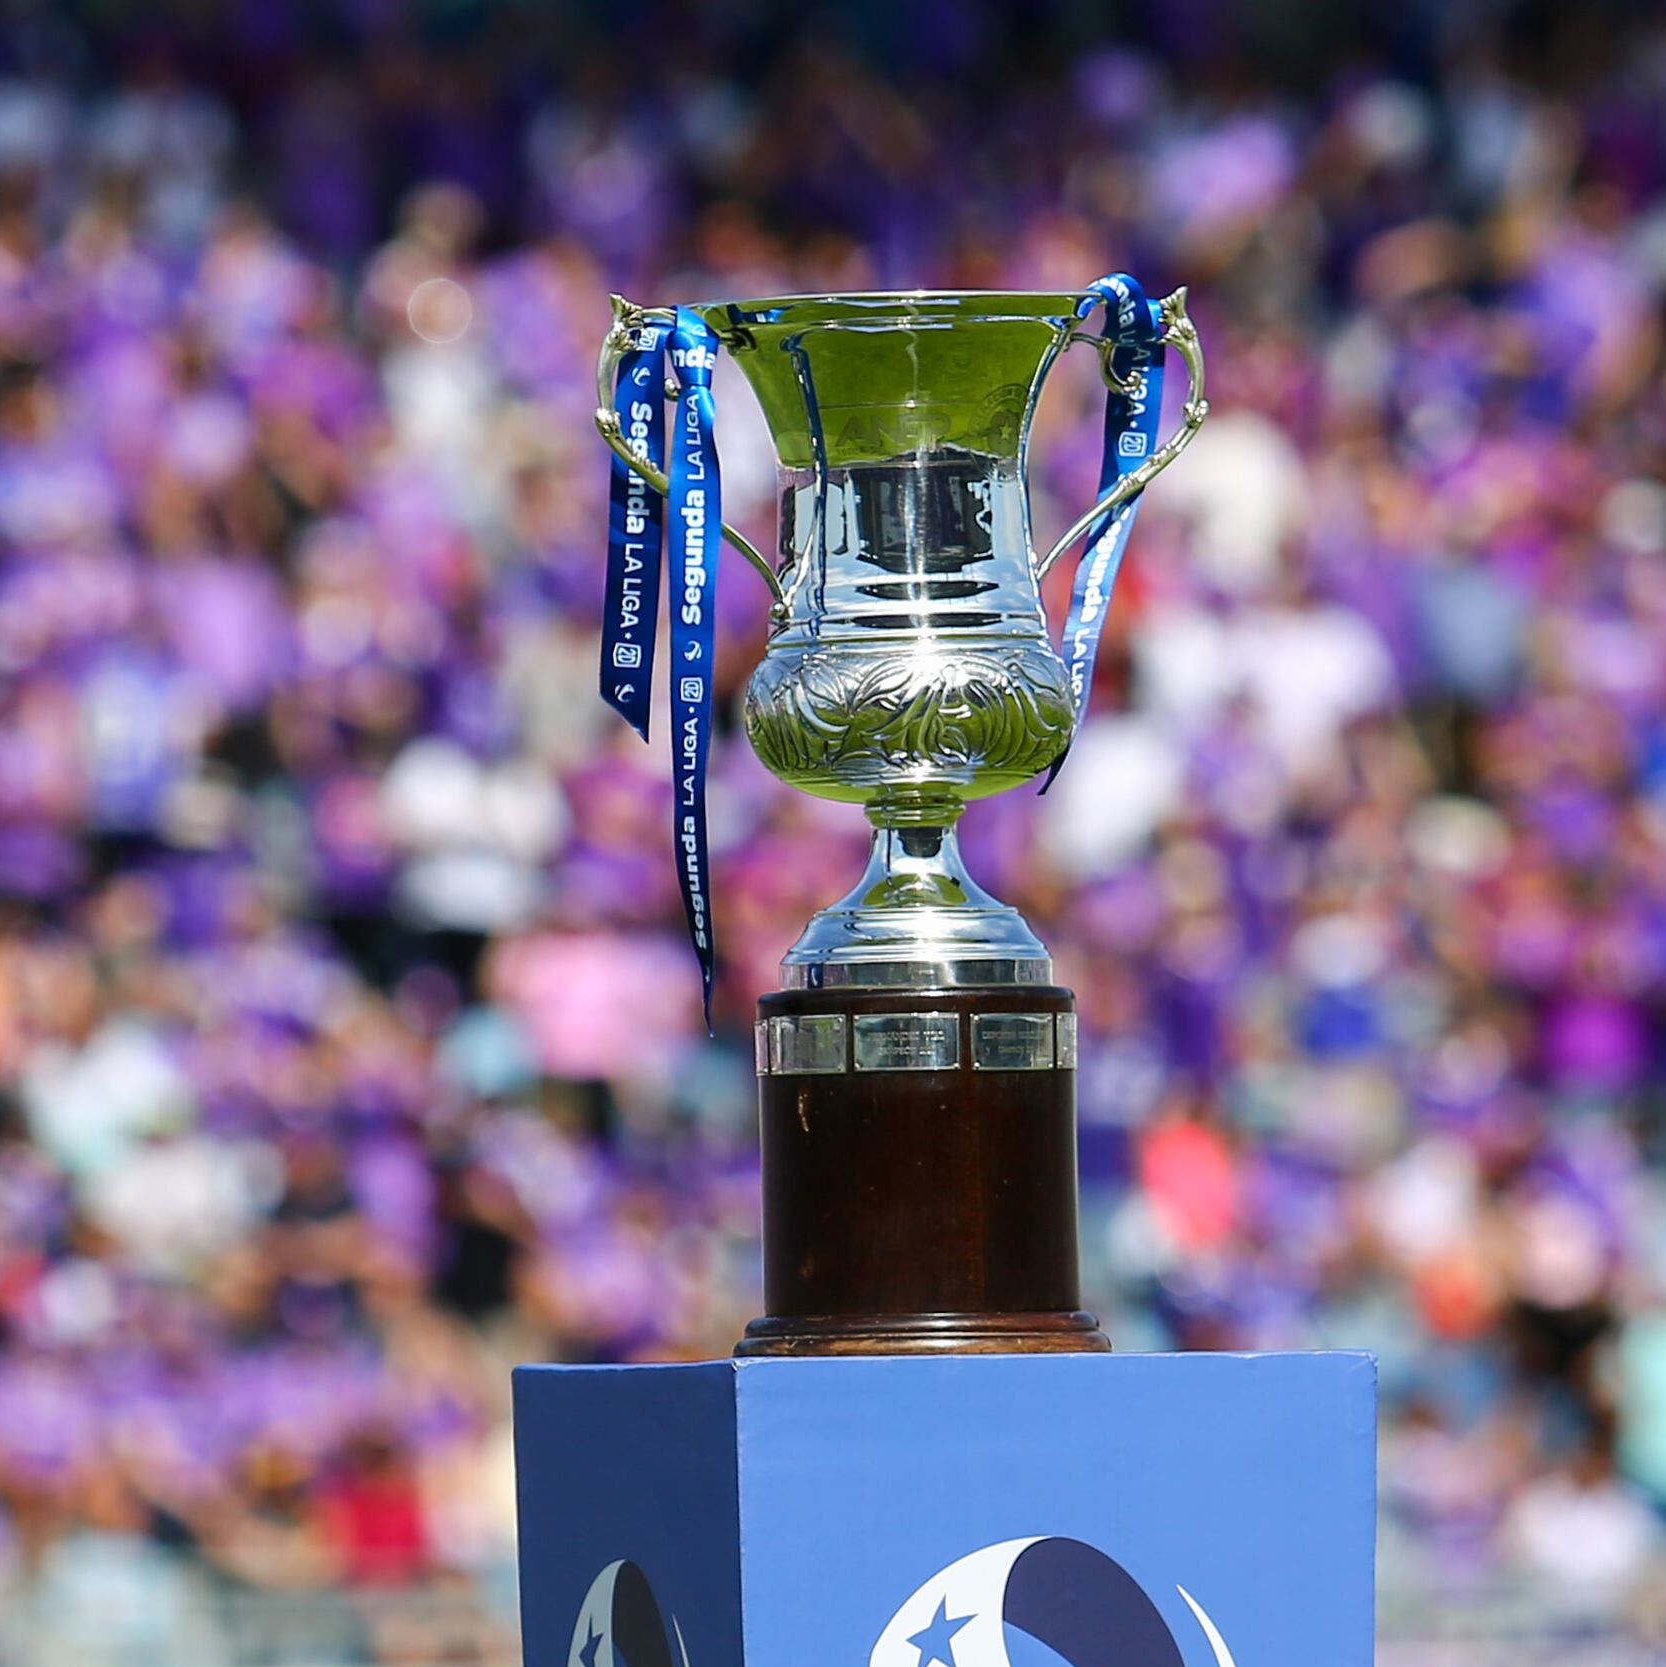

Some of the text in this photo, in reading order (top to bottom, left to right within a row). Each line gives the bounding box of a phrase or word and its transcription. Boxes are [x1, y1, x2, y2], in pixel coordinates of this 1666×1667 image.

[626, 401, 653, 534] Segnda
[681, 394, 706, 625] Segunda LA LIGA
[624, 544, 644, 573] LA
[620, 579, 642, 628] LIGA
[1073, 628, 1090, 660] LA
[683, 718, 699, 770] LIGA
[684, 776, 695, 806] LA
[681, 816, 707, 949] Segunda
